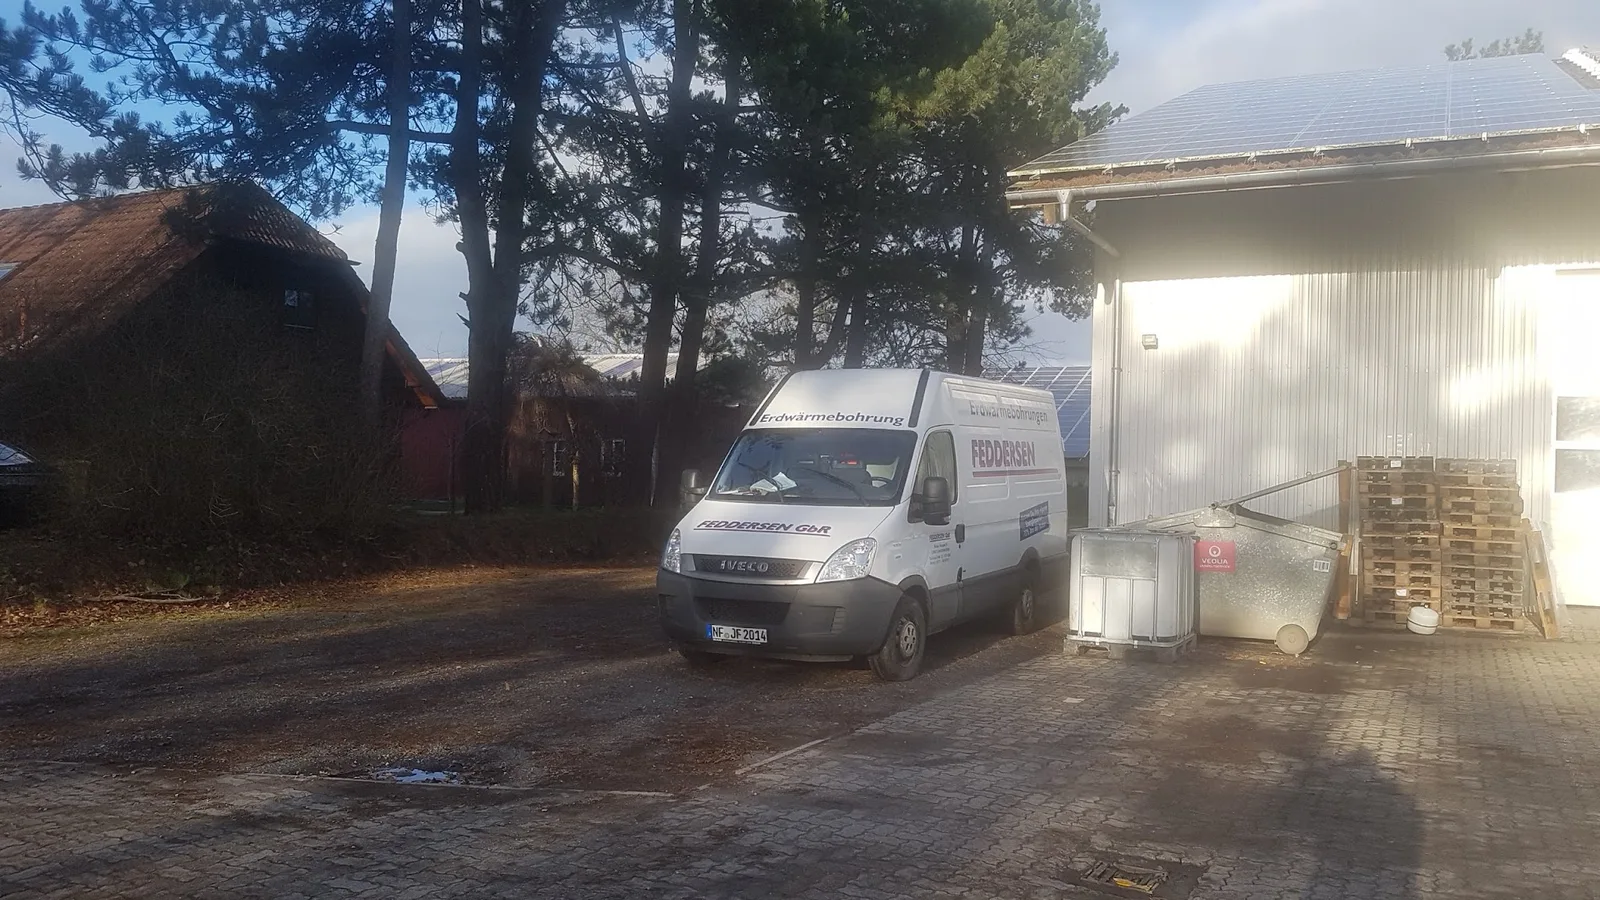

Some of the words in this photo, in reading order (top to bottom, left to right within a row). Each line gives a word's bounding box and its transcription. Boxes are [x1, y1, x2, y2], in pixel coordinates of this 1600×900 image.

[759, 412, 904, 426] Erdwärmebohrung
[971, 439, 1036, 468] FEDDERSEN
[697, 520, 793, 531] FEDDERSEN
[795, 524, 832, 534] GbR
[720, 560, 769, 572] IVECO
[712, 626, 724, 638] NF
[730, 627, 742, 639] JF
[743, 629, 766, 641] 2014
